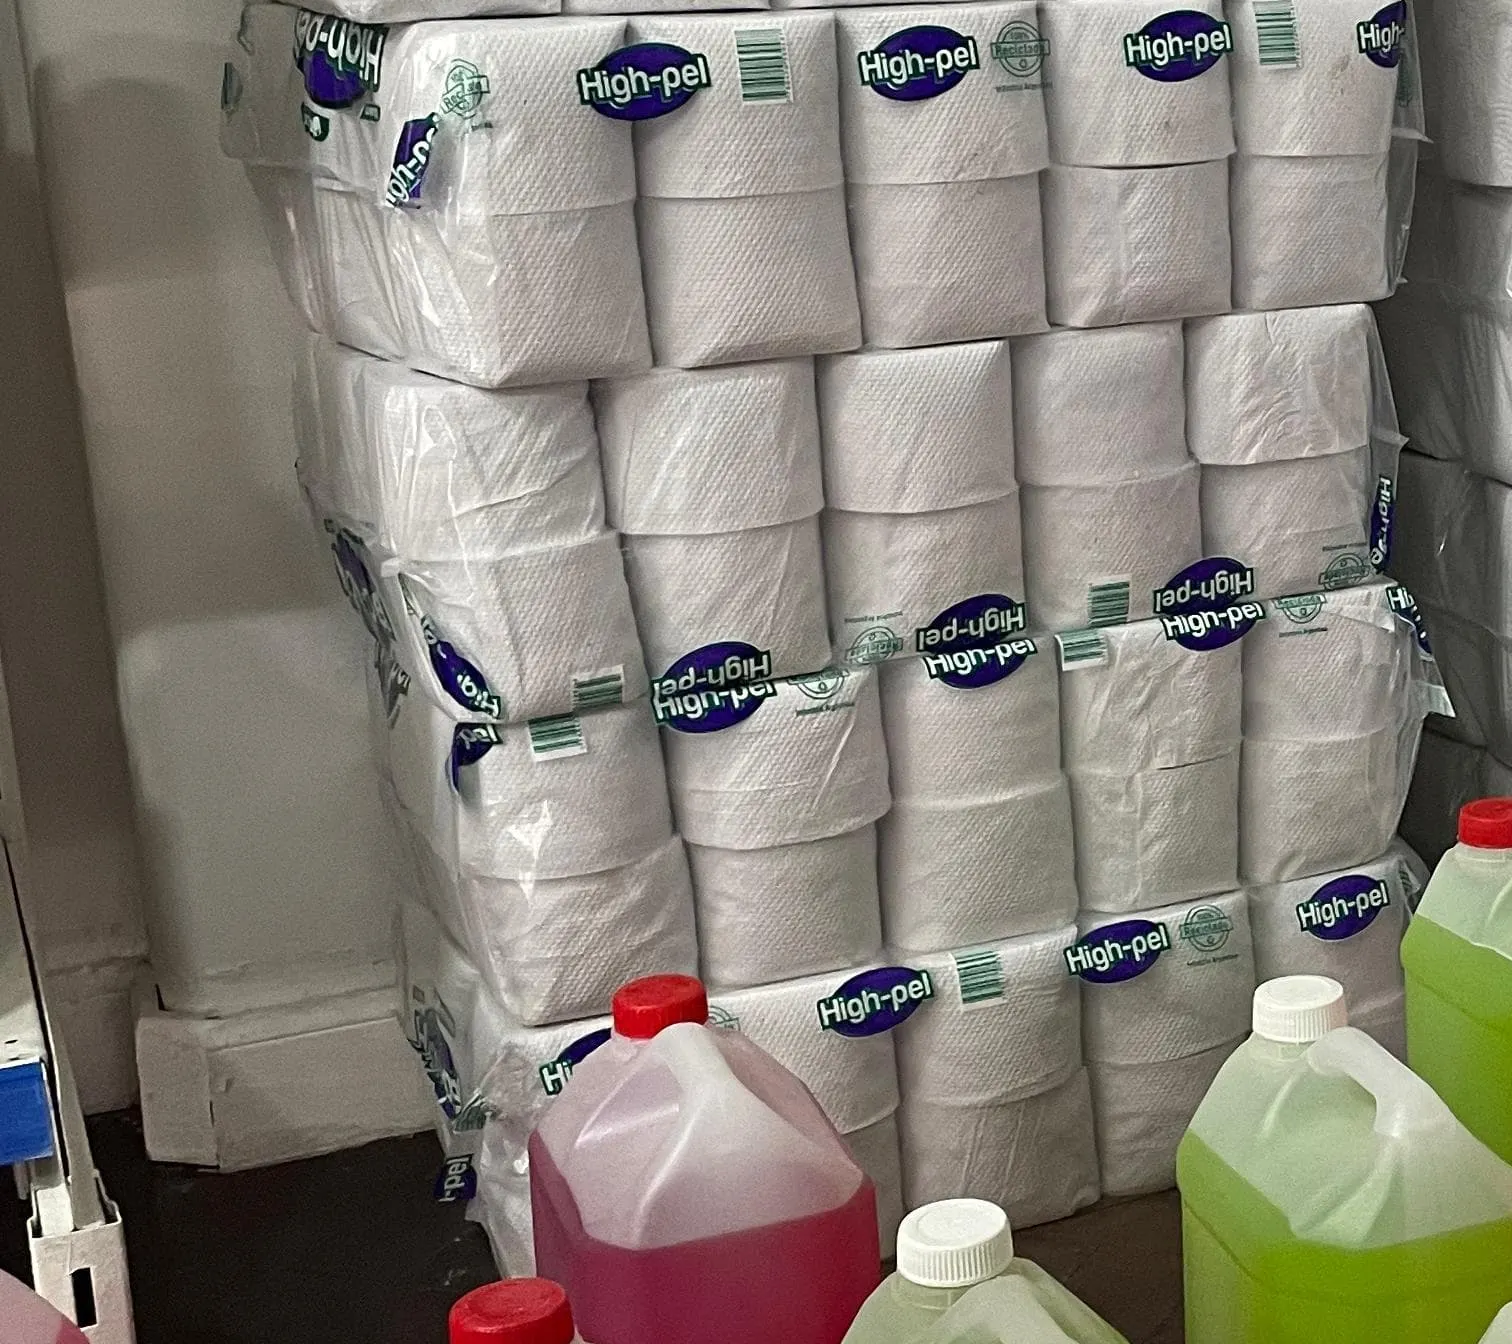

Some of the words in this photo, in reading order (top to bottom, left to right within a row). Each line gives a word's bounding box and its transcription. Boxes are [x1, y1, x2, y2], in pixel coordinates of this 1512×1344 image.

[1125, 24, 1232, 66] High-pel
[1358, 21, 1405, 53] High-
[579, 56, 708, 103] High-pel
[860, 39, 978, 85] High-pel
[1155, 570, 1252, 612] High-pel
[918, 606, 1024, 650] High-pel
[653, 654, 770, 698] High-pel
[1298, 882, 1389, 929] High-pel
[1065, 924, 1169, 973] High-pel
[819, 972, 932, 1026] High-pel
